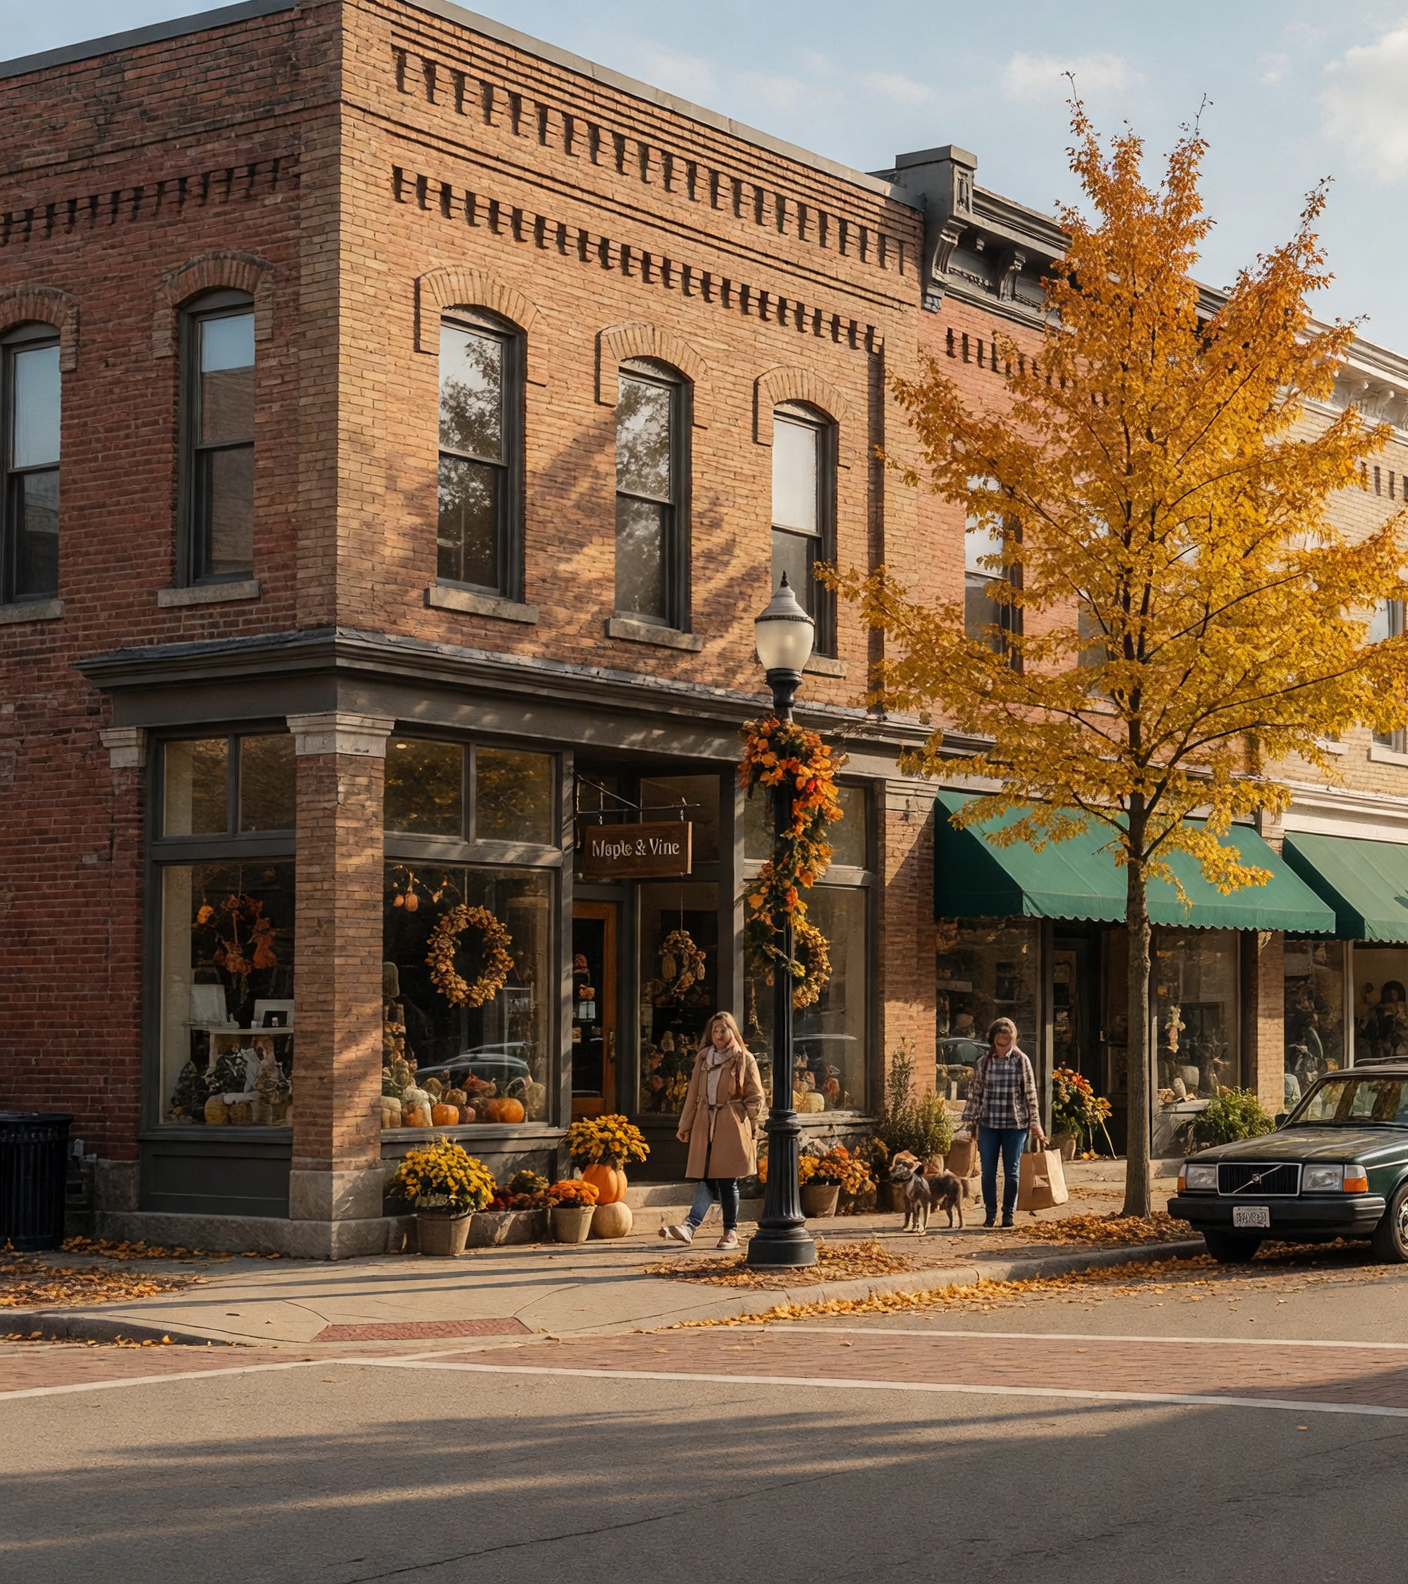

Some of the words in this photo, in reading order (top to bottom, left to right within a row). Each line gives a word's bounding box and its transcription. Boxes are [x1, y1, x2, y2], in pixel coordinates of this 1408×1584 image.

[592, 840, 632, 859] Maple
[635, 839, 647, 856] &
[649, 838, 680, 855] Vine
